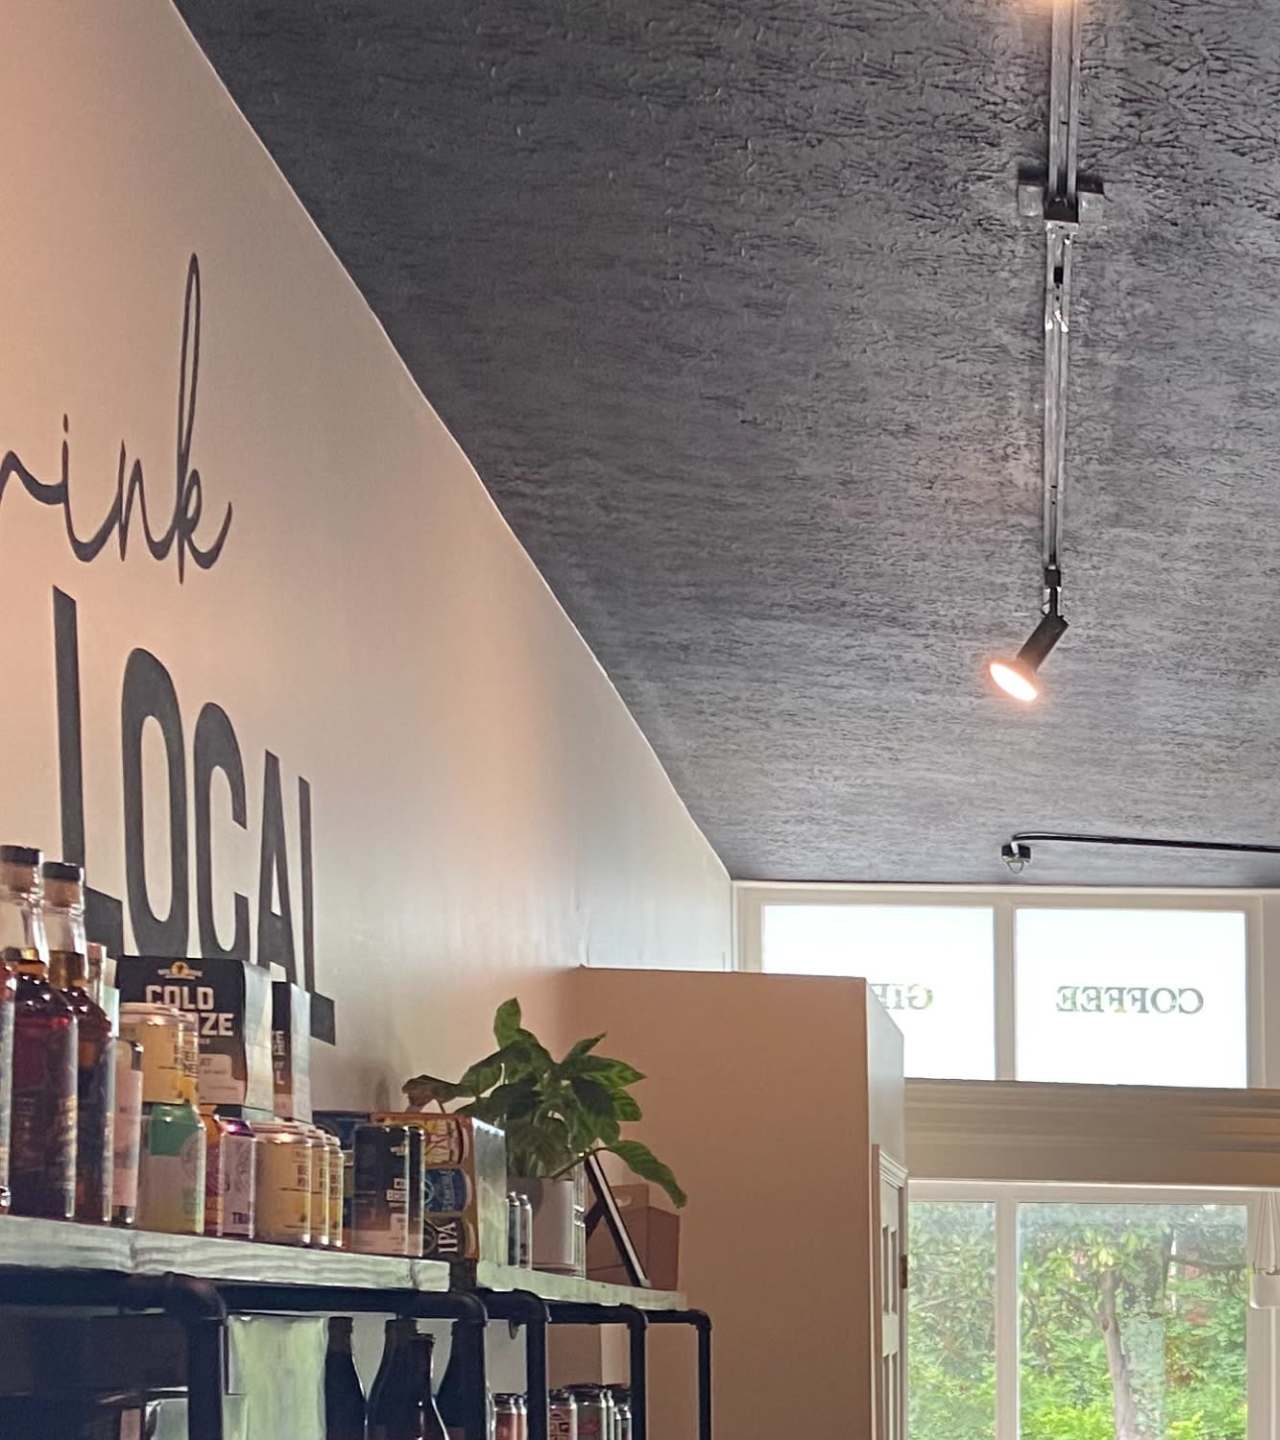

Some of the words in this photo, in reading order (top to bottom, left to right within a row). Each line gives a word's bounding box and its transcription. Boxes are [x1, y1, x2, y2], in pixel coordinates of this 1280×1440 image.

[52, 585, 336, 1045] LOCAL
[145, 985, 215, 1011] COLD
[437, 1222, 458, 1253] IPA
